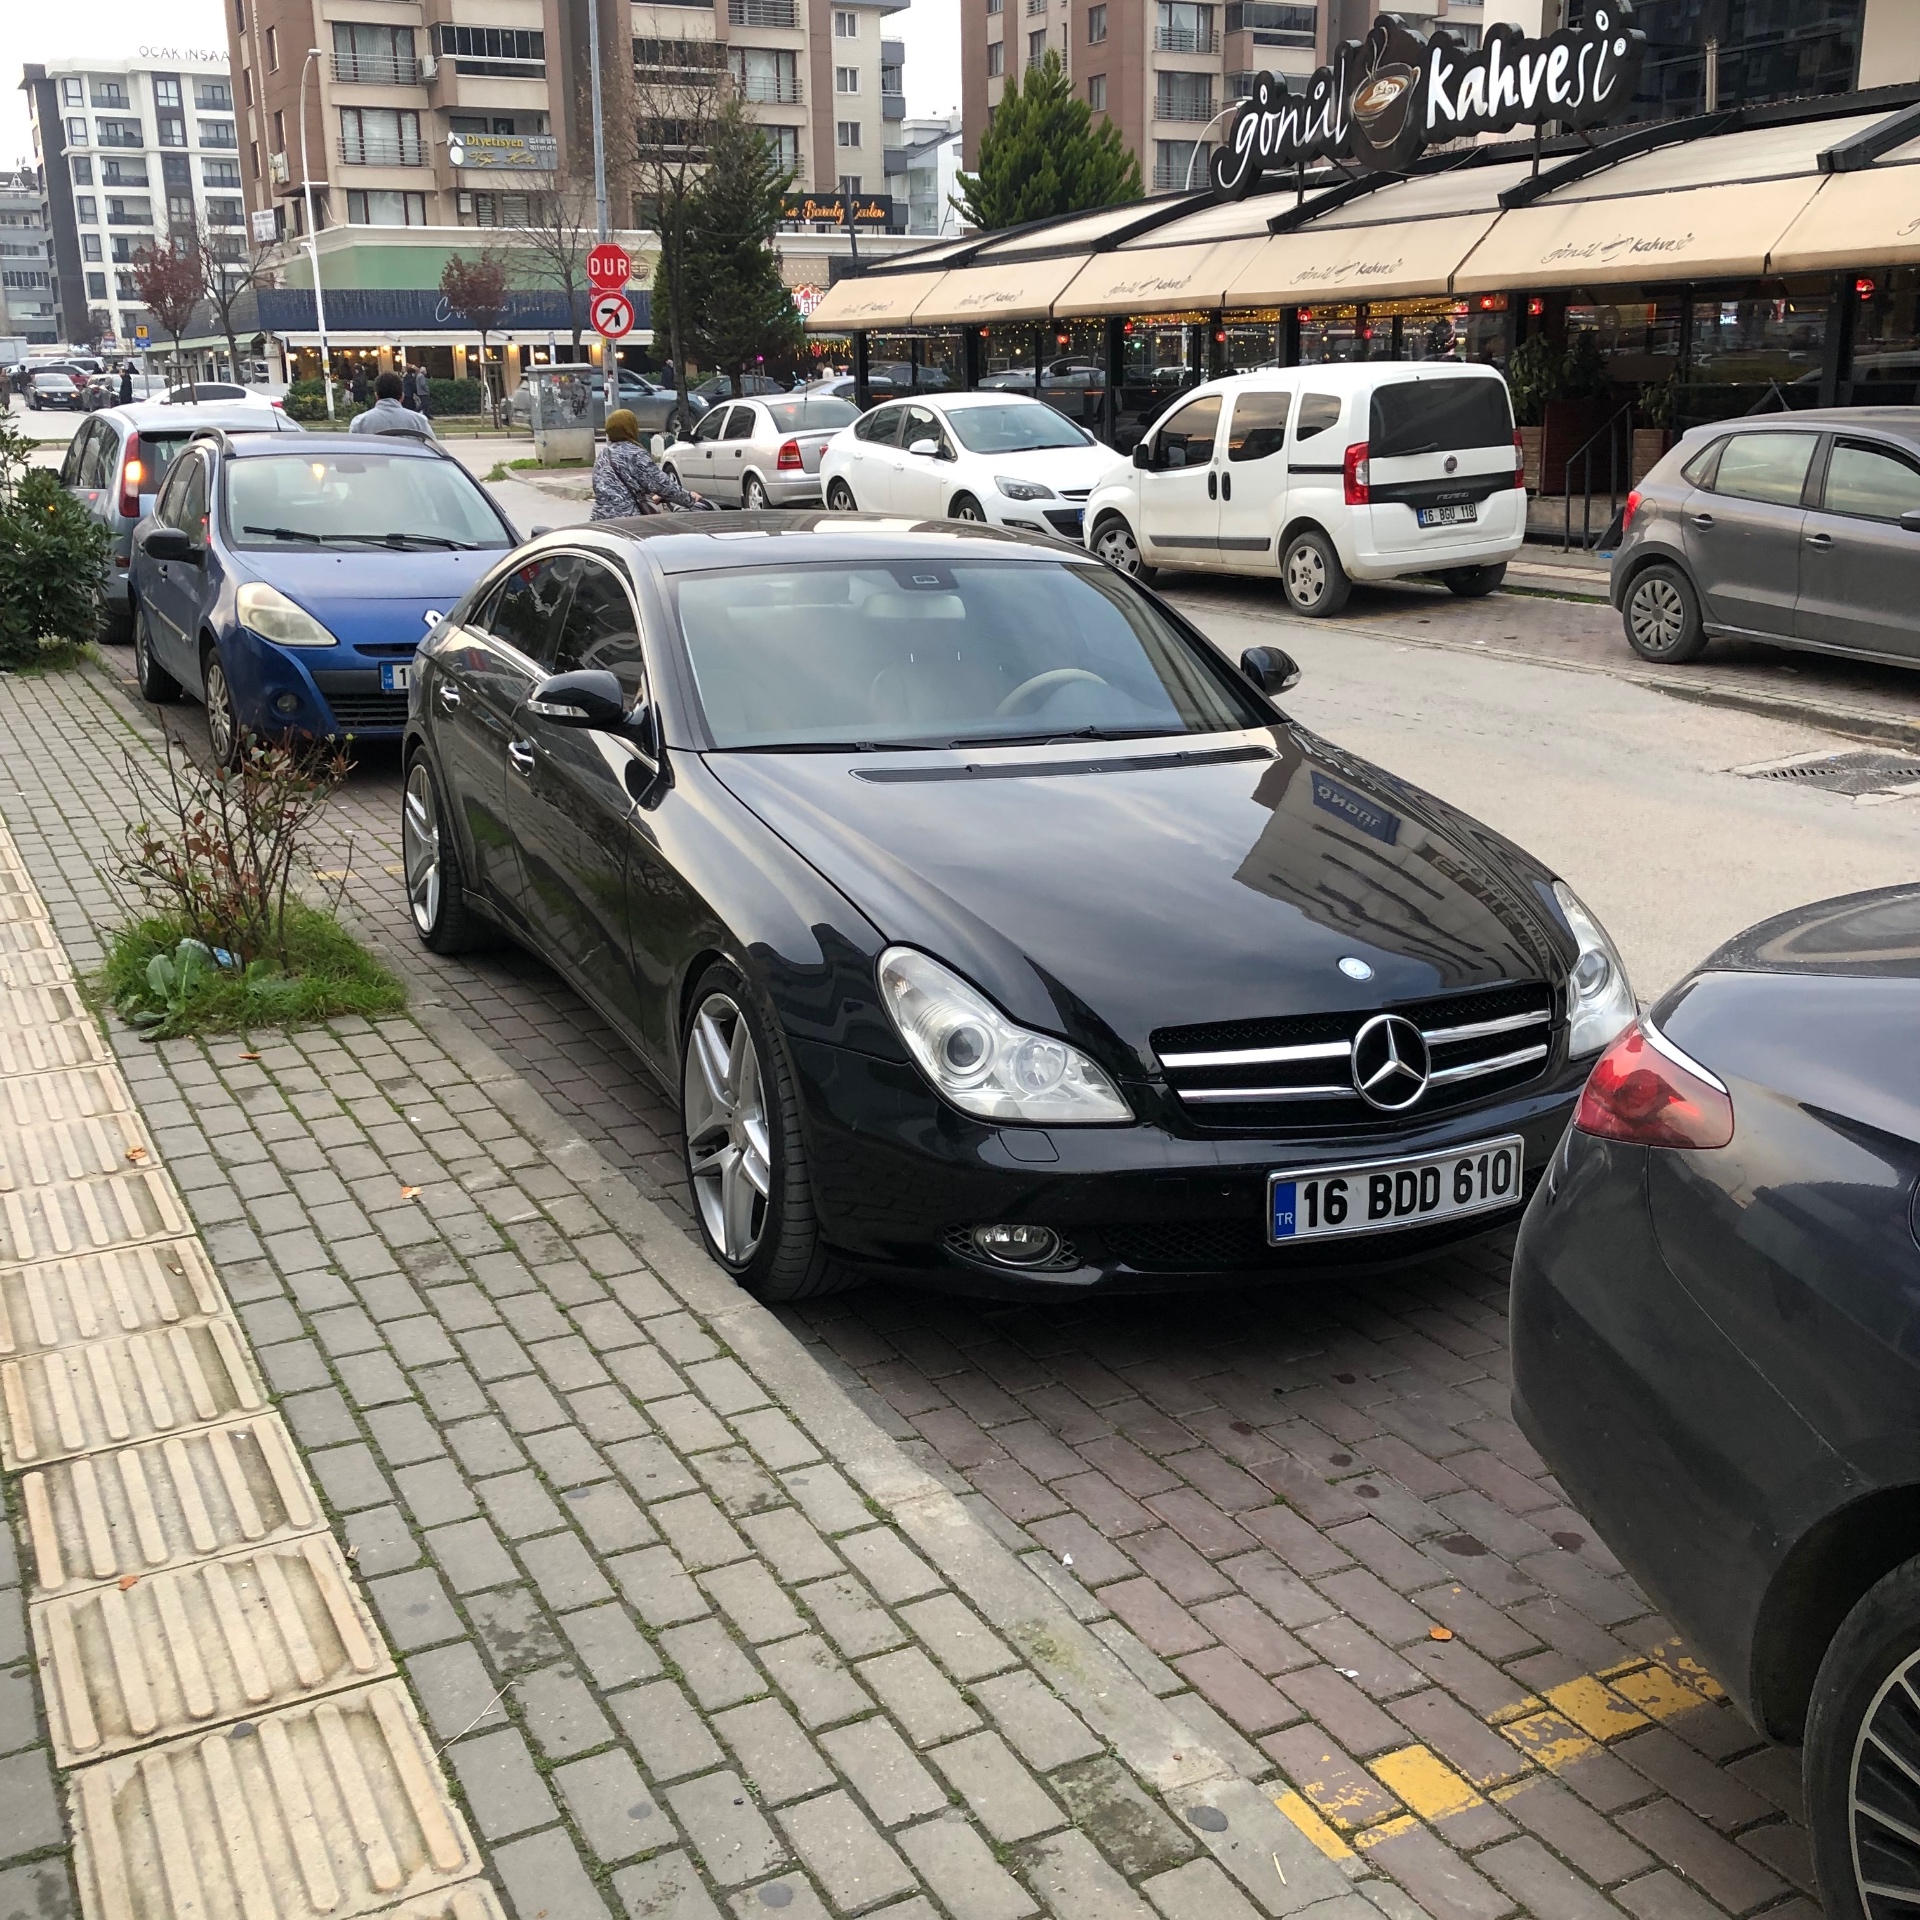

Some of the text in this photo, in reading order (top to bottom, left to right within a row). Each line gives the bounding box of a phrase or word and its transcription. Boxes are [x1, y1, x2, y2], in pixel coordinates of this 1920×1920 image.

[139, 45, 181, 59] OCAK
[1217, 55, 1349, 189] gönül
[465, 134, 524, 149] Diyetisyen
[802, 199, 845, 226] Beauty
[590, 257, 628, 277] DUR
[1424, 510, 1434, 522] 16
[1439, 507, 1455, 520] BGU
[1461, 505, 1474, 518] 118
[1303, 1149, 1513, 1228] 16 BDD 610
[1276, 1211, 1293, 1226] TR
